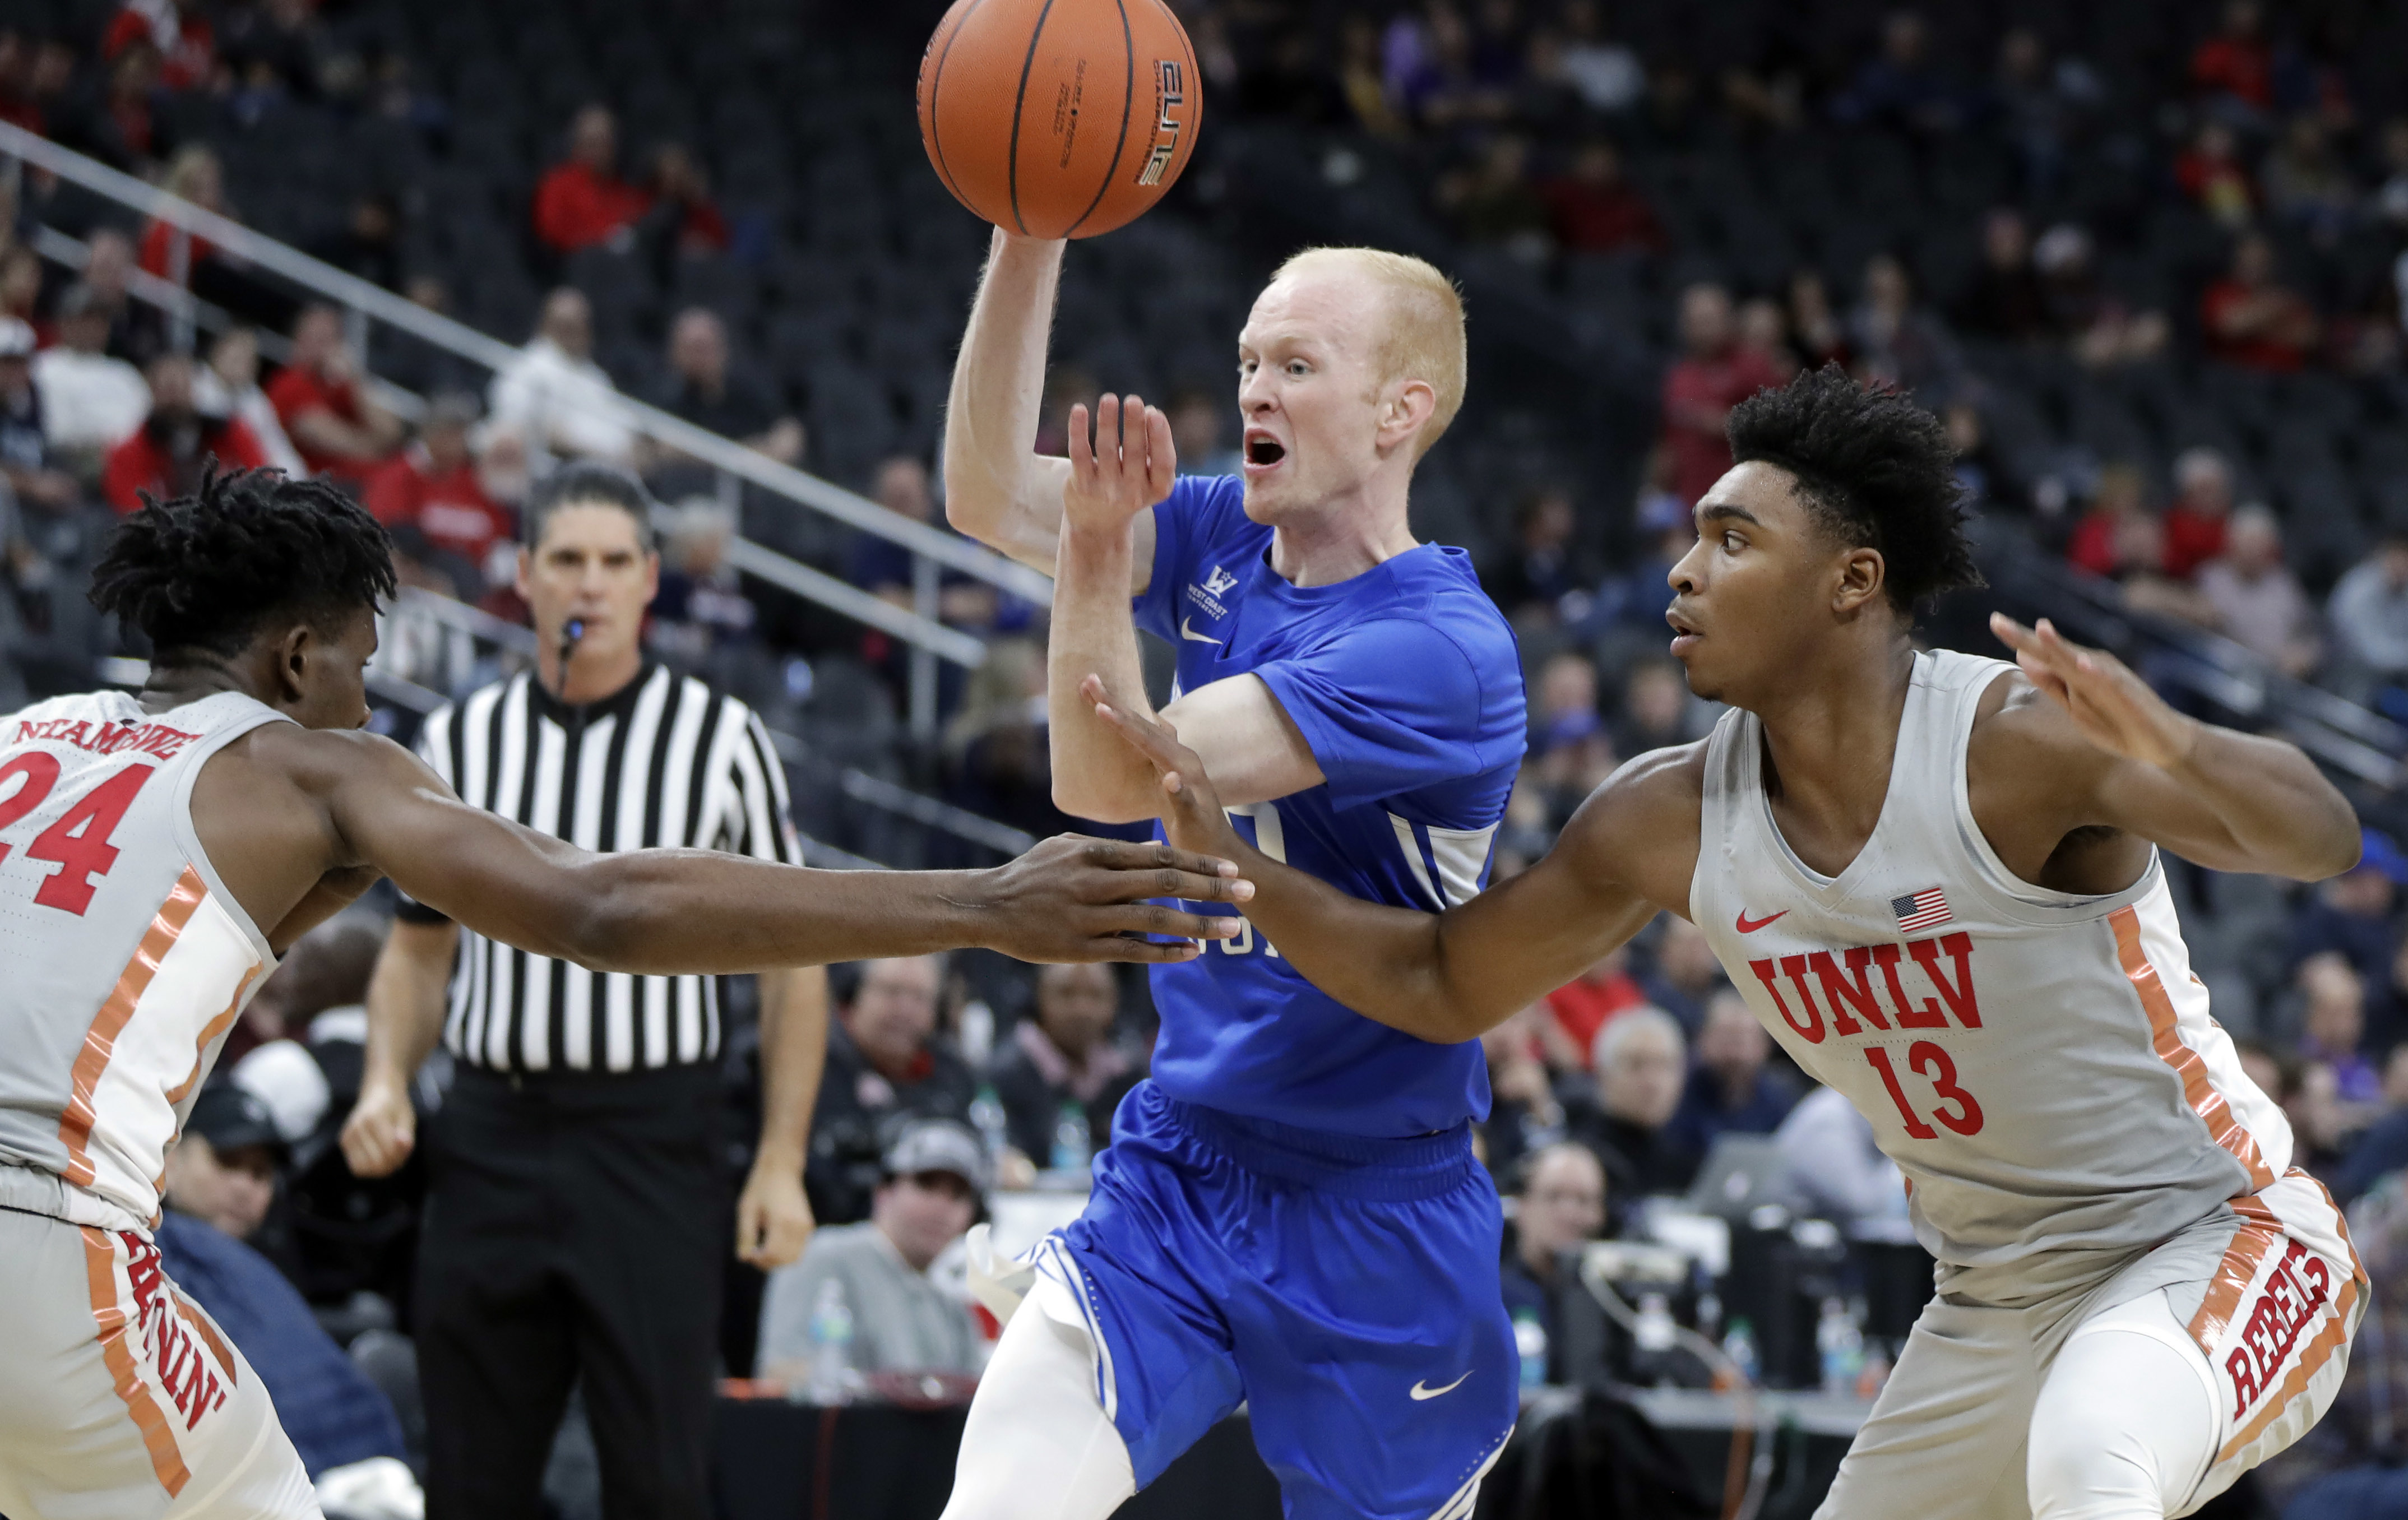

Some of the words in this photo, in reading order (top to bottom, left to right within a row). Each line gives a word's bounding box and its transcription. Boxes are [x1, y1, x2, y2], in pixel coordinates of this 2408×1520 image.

[1138, 59, 1183, 187] ELITE
[1187, 594, 1221, 621] CONFERENCE
[1188, 583, 1206, 601] WEST
[1205, 596, 1228, 616] COAST
[12, 719, 205, 761] NTAMBWE
[0, 751, 156, 916] 24
[1748, 931, 1983, 1044] UNLV
[1864, 1041, 1984, 1139] 13
[2225, 1238, 2330, 1422] REBELS
